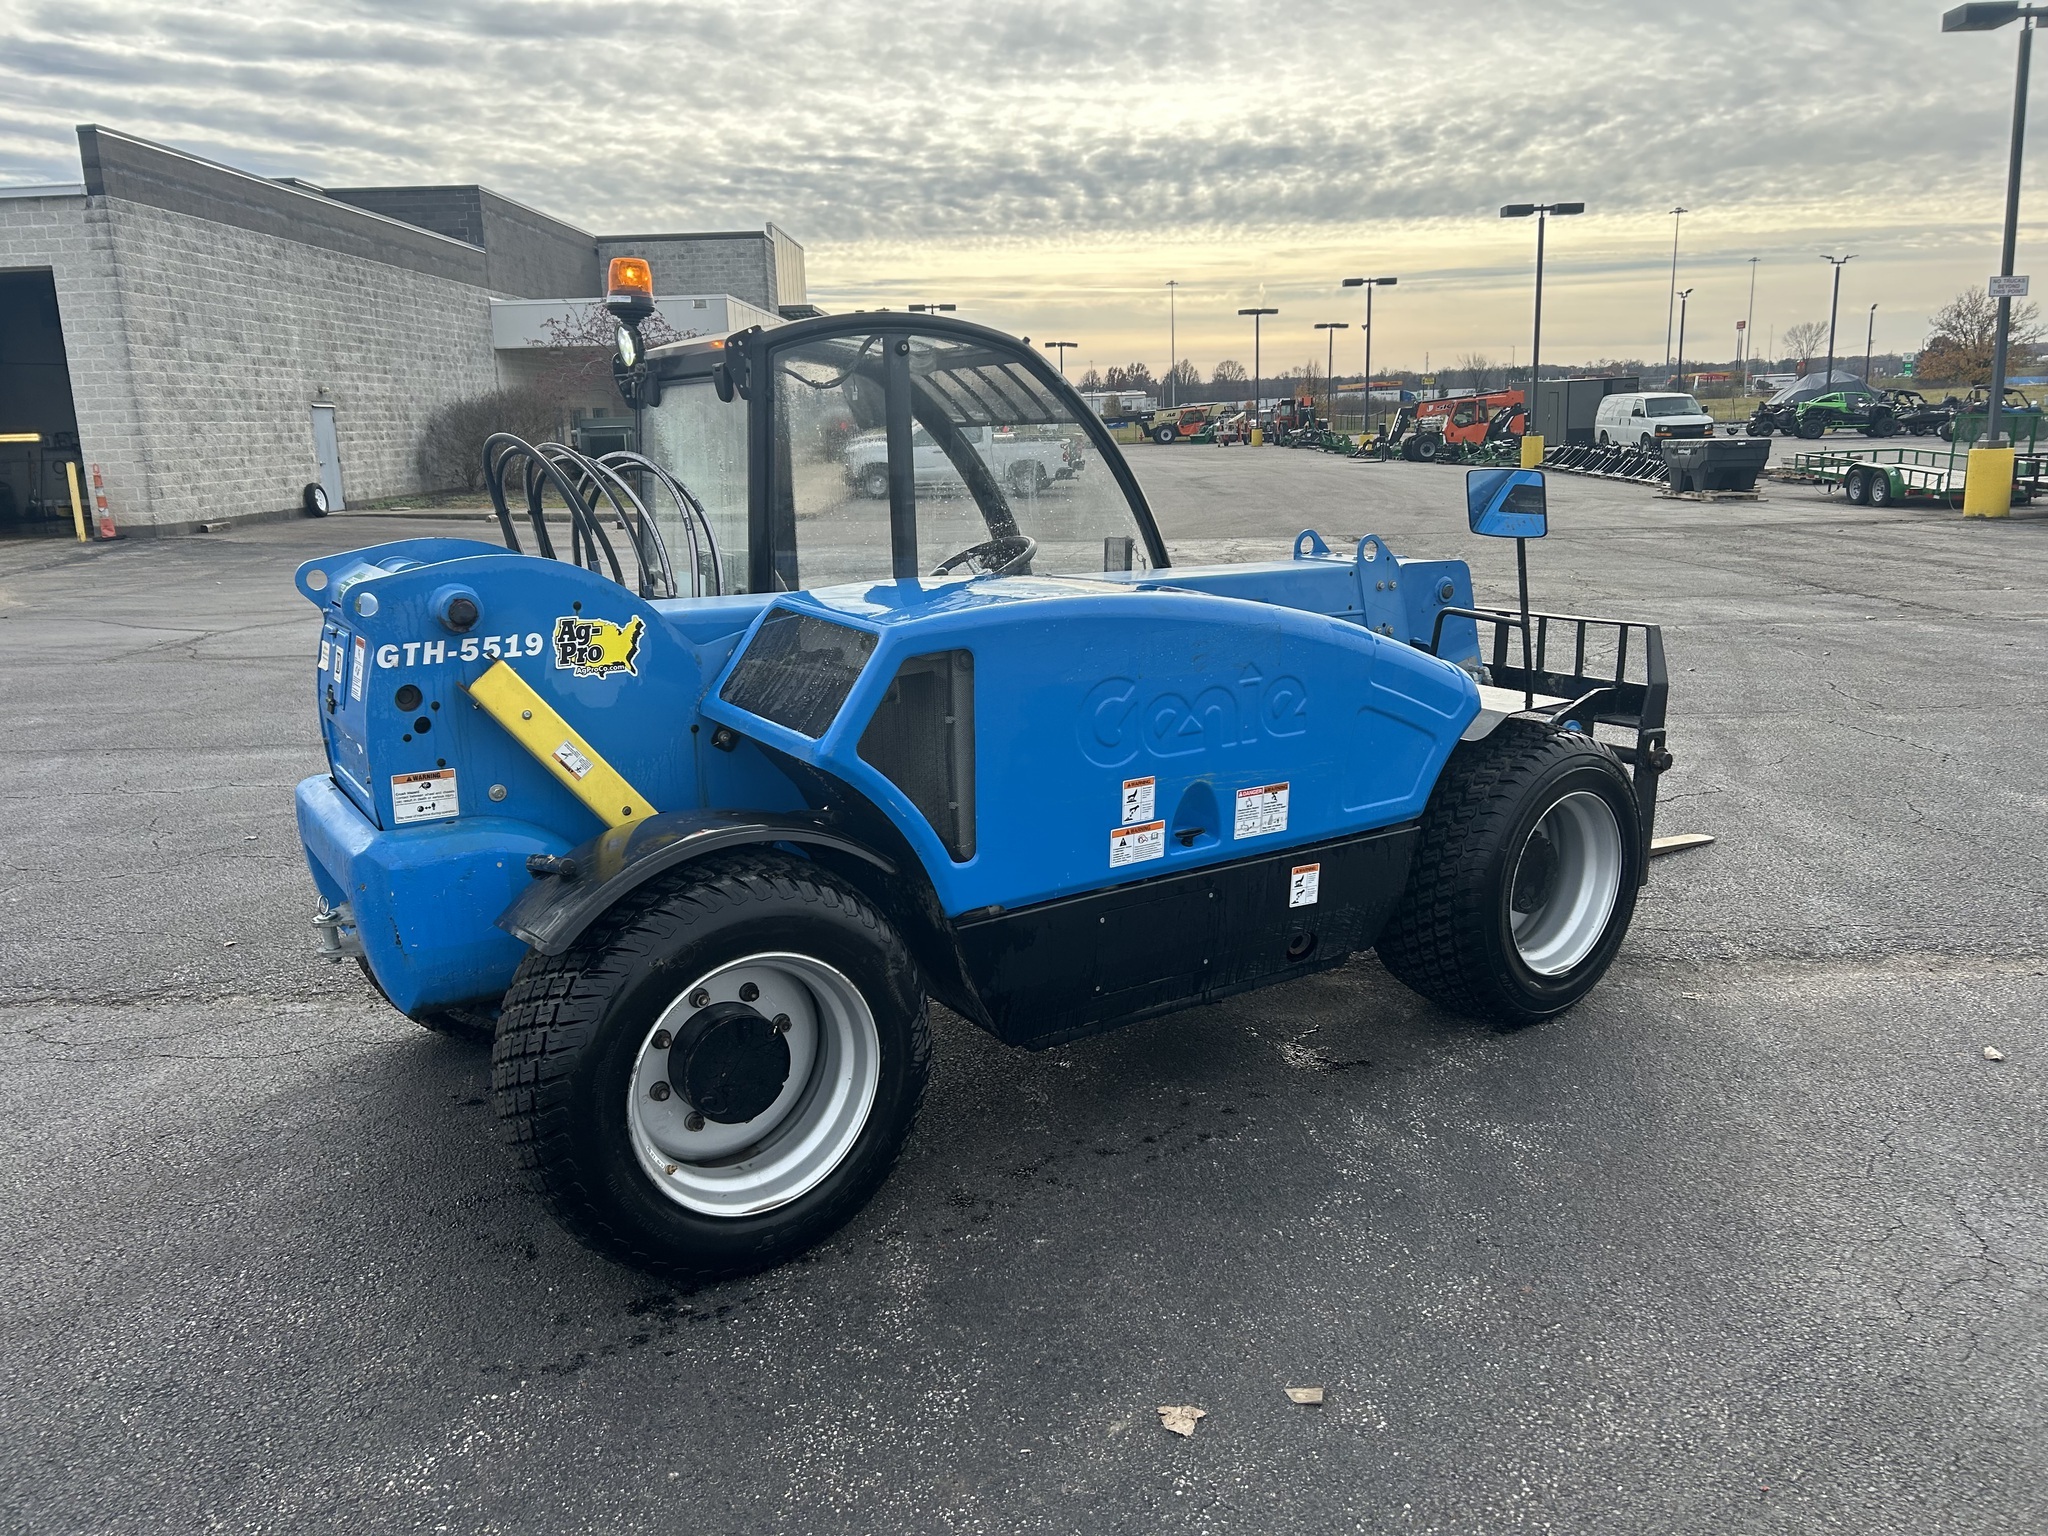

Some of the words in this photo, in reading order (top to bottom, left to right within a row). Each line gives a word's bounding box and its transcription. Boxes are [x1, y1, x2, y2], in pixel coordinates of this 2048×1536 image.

[557, 620, 602, 646] Ag-
[376, 632, 544, 669] GTH-5519
[559, 642, 603, 665] Pro
[577, 664, 625, 675] AgProCo.com
[1076, 662, 1307, 768] Genie
[412, 772, 441, 781] WARNING
[1243, 788, 1263, 796] DANGER
